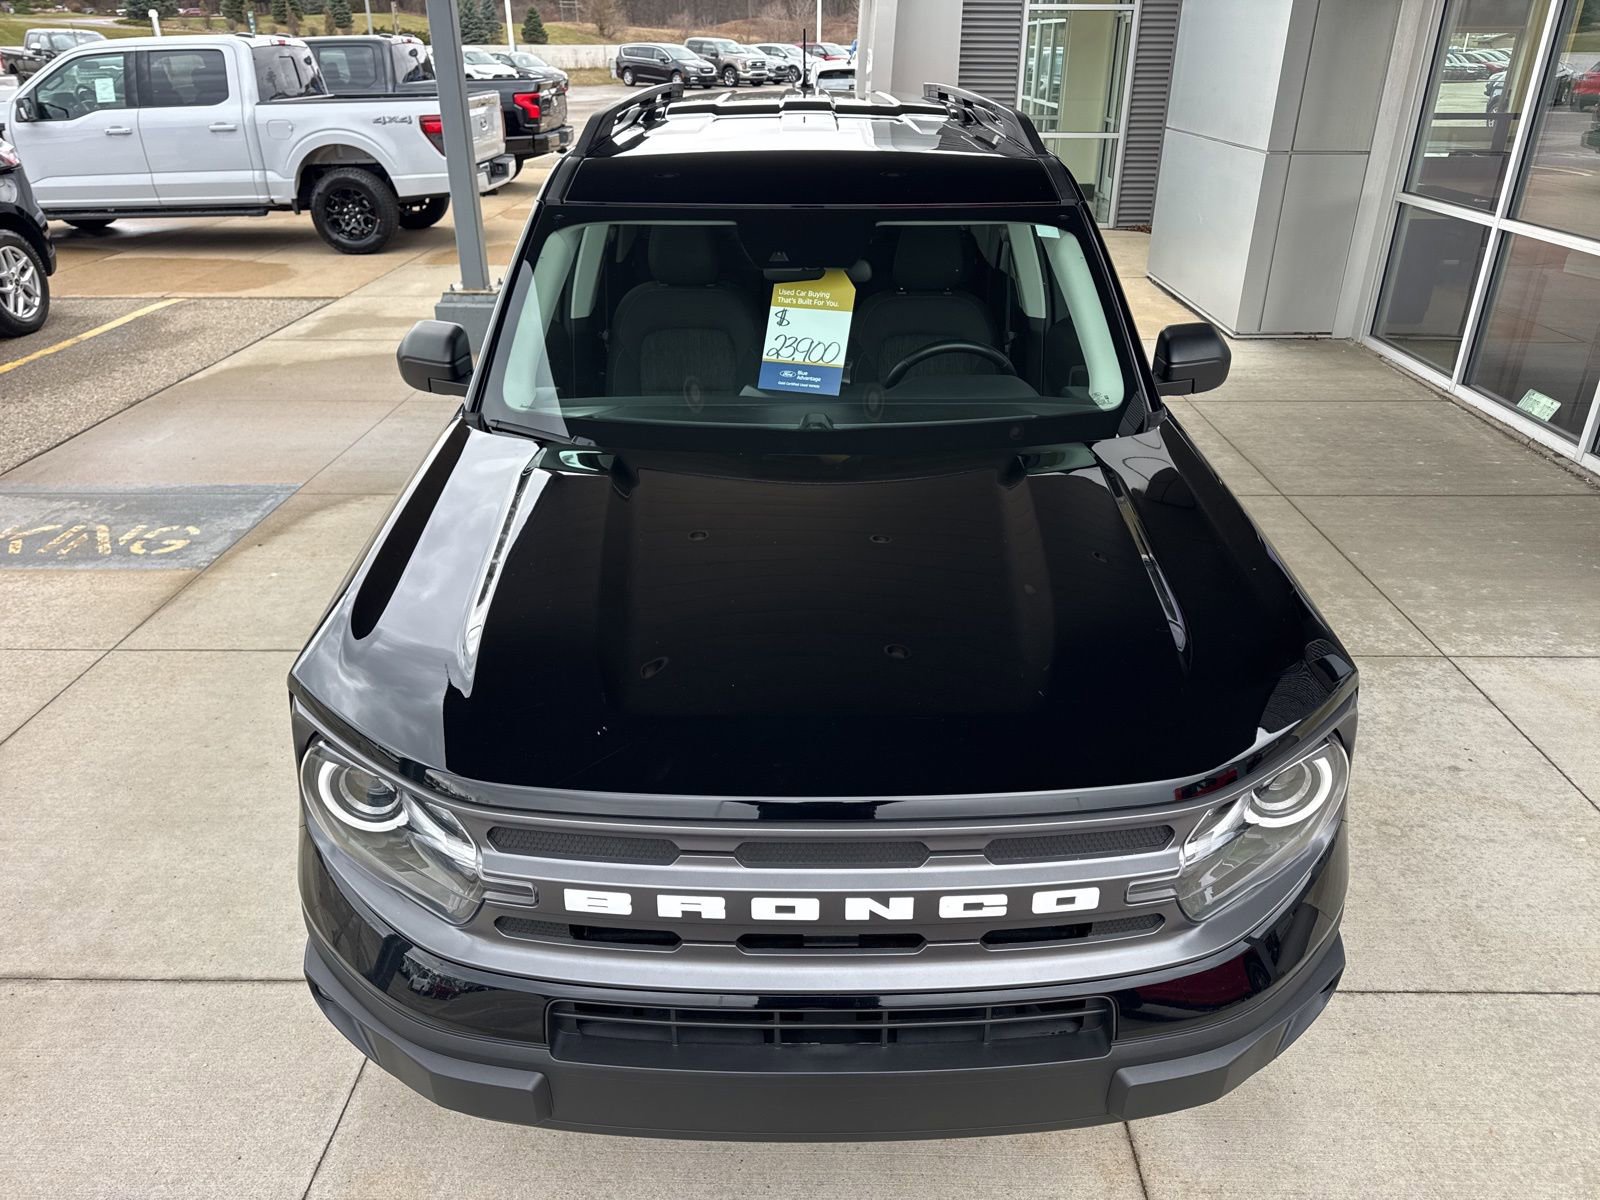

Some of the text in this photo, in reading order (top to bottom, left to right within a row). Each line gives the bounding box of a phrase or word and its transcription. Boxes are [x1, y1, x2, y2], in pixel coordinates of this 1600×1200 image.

[778, 296, 797, 304] That's
[798, 297, 813, 305] Built
[796, 289, 808, 297] Car
[809, 290, 830, 299] Buying
[774, 308, 790, 327] $
[563, 886, 1101, 921] BRONCO
